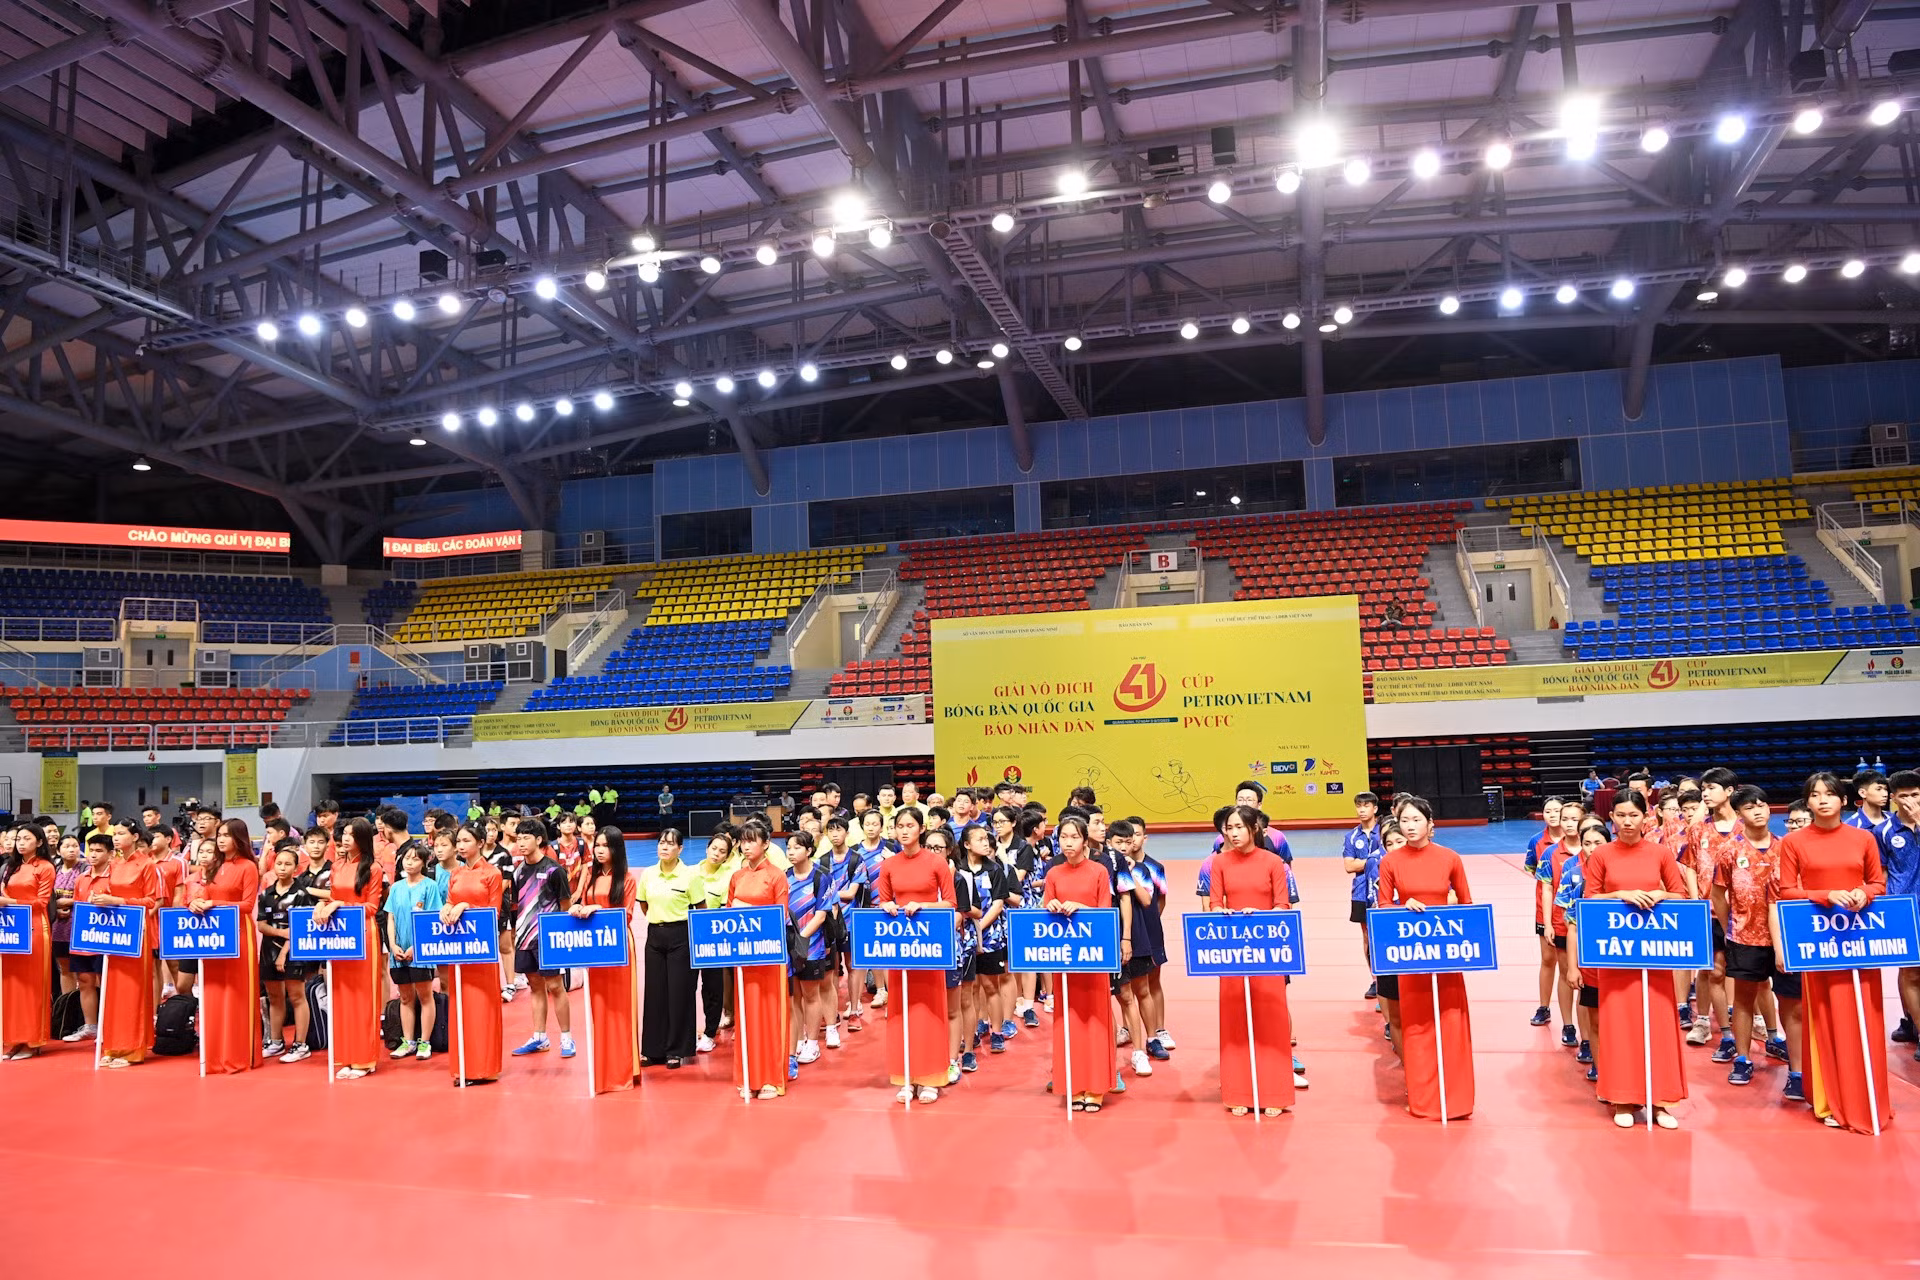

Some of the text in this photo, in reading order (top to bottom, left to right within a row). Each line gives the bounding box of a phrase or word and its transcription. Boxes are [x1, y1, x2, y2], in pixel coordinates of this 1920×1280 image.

[128, 529, 168, 542] CHÀO
[170, 530, 211, 544] MỪNG
[214, 532, 237, 546] QUÍ
[240, 536, 252, 548] VỊ
[254, 536, 276, 550] ĐẠI
[392, 542, 412, 555] ĐẠI
[442, 539, 463, 550] CÁC
[466, 536, 493, 550] ĐOÀN
[495, 535, 516, 548] VẬN
[1158, 555, 1170, 568] B
[1575, 665, 1595, 674] GIẢI
[1599, 664, 1612, 672] VÔ
[1651, 661, 1673, 682] 41
[1687, 659, 1707, 668] CÚP
[1688, 666, 1766, 678] PETROVIETNAM
[1120, 663, 1156, 699] 41
[1182, 673, 1214, 689] CÚP
[1543, 675, 1568, 684] BÓNG
[1572, 674, 1590, 683] BÀN
[1594, 672, 1620, 683] QUỐC
[1688, 678, 1720, 687] PVCFC
[994, 681, 1093, 698] GIẢI VÔ ĐỊCH
[1569, 682, 1639, 693] BÁO NHÂN DÂN
[1184, 690, 1312, 708] PETROVIETNAM
[668, 708, 683, 725] 41
[944, 699, 1094, 718] BÓNG BÀN QUỐC GIA
[984, 719, 1095, 736] BÁO NHÂN DÂN
[1184, 715, 1234, 728] PVCFC
[148, 752, 155, 761] 4
[88, 910, 127, 927] ĐOÀN
[711, 914, 762, 934] ĐOÀN
[874, 917, 930, 937] ĐOÀN
[1397, 916, 1464, 938] ĐOÀN
[81, 928, 131, 946] ĐỒNG NAI
[1033, 918, 1092, 938] ĐOÀN
[1195, 921, 1290, 942] CÂU LẠC BỘ
[174, 933, 225, 950] HÀ NỘI
[298, 934, 356, 950] HẢI PHÒNG
[422, 938, 489, 956] KHÁNH HÒA
[548, 926, 617, 952] TRỌNG TÀI
[695, 943, 716, 958] LONG
[717, 938, 731, 956] HẢI
[738, 937, 752, 955] HẢI
[754, 939, 781, 955] DƯƠNG
[864, 938, 942, 958] LÂM ĐỒNG
[1596, 936, 1693, 957] TÂY NINH
[1798, 936, 1908, 959] TP HỒ CHÍ MINH
[1024, 944, 1103, 964] NGHỆ AN
[1197, 945, 1292, 964] NGUYÊN VÕ
[1386, 940, 1480, 962] QUÂN ĐỘI
